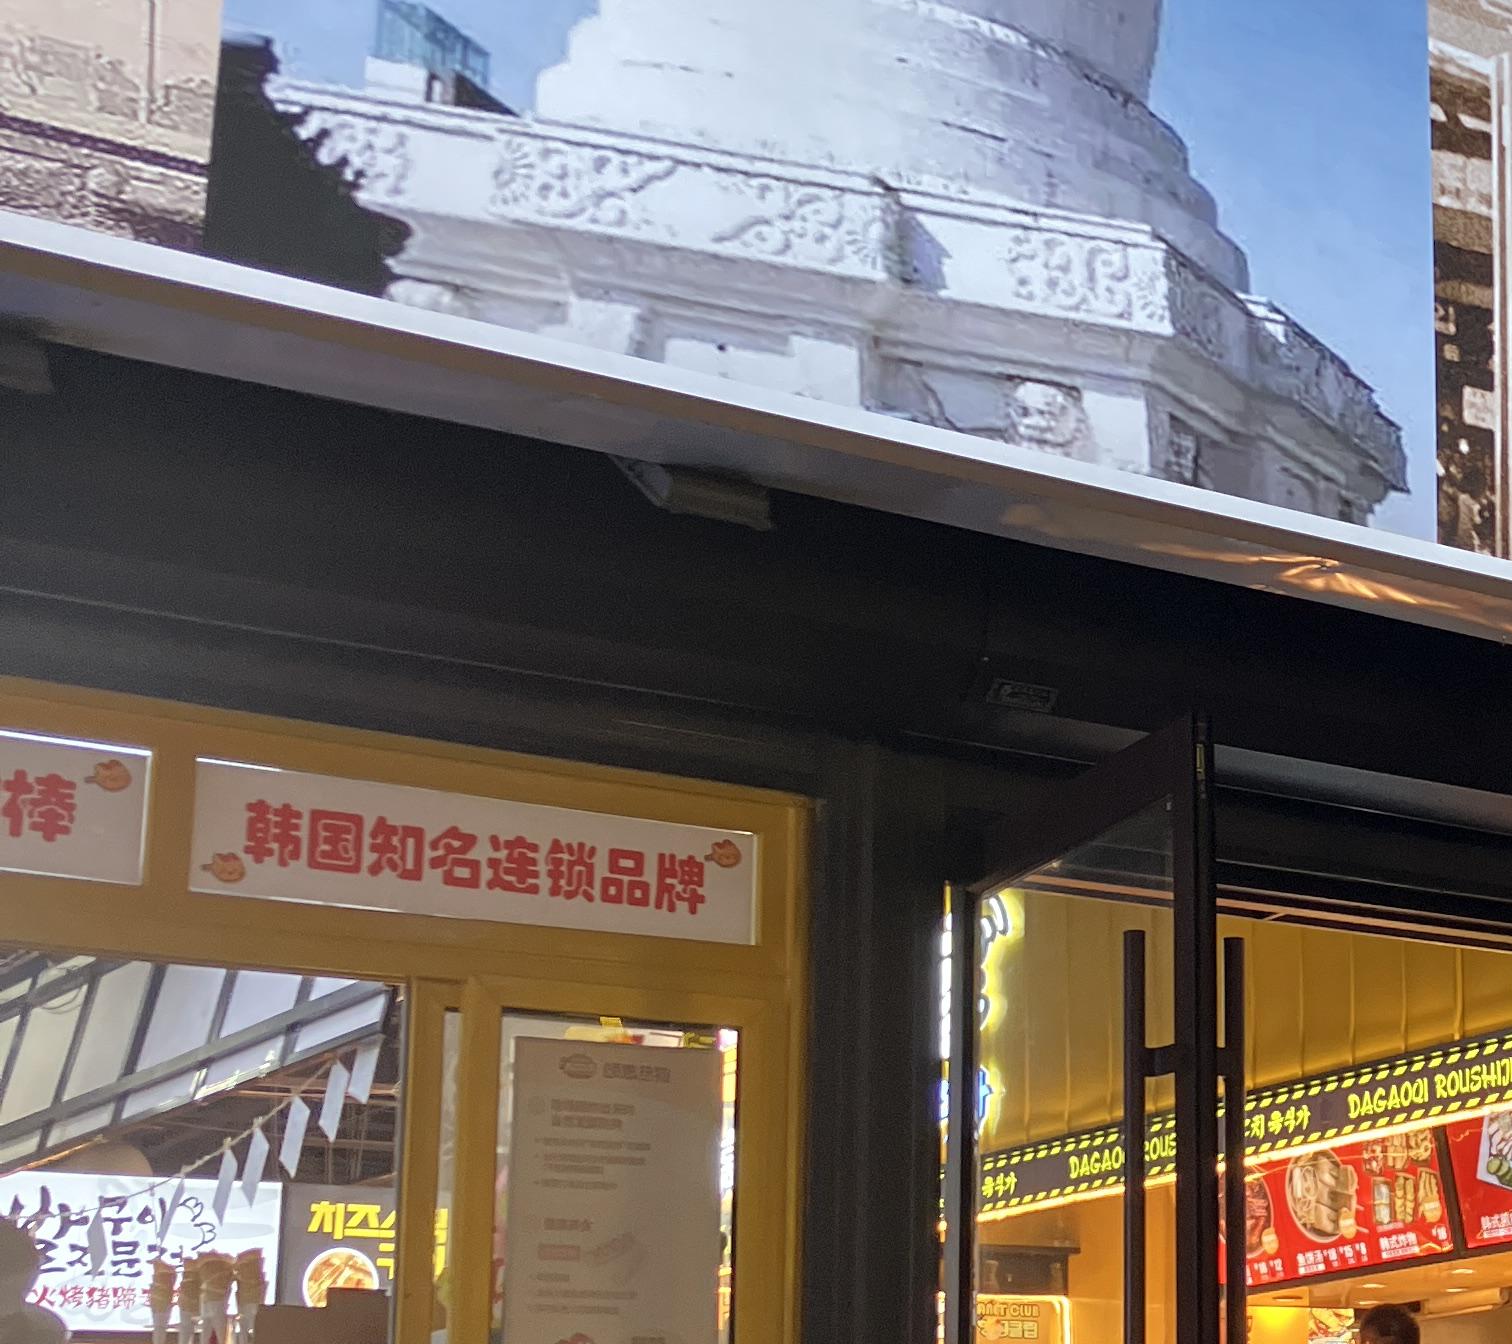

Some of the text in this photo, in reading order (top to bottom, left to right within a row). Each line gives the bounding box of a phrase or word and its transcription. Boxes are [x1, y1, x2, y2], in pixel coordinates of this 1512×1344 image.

[2, 768, 77, 843] 棒
[243, 799, 706, 915] 韩国知名连锁品牌
[1347, 1085, 1428, 1119] DAGAOQI
